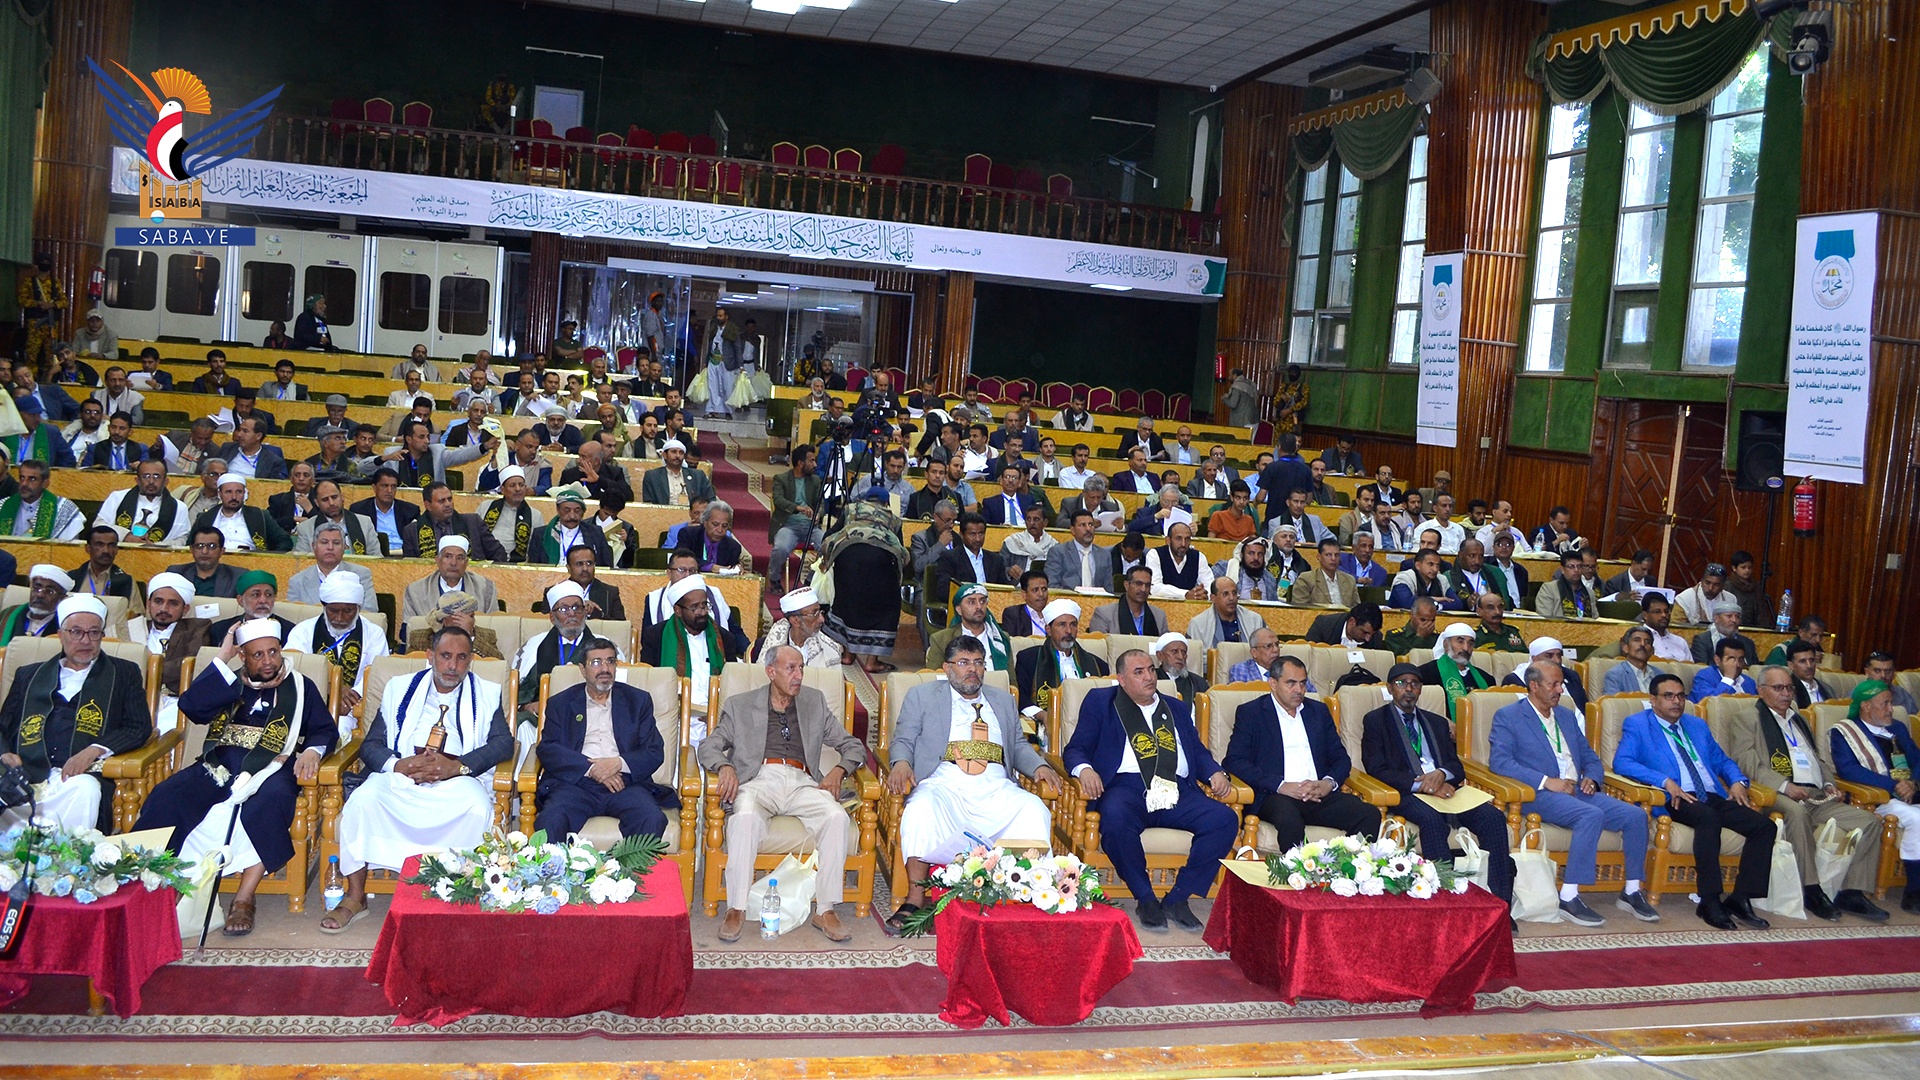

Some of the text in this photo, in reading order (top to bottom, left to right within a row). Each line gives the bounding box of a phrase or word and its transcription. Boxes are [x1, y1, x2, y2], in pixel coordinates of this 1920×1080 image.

[930, 243, 982, 256] قال سبحانه وتعالى
[1823, 324, 1833, 332] كان
[1852, 325, 1867, 333] رسول
[1823, 353, 1839, 362] مستوى
[1839, 352, 1852, 362] أعلى
[1852, 353, 1863, 362] على
[1859, 367, 1866, 376] أن
[1808, 395, 1844, 405] قائد في التاريخ
[2, 908, 18, 934] EOS
